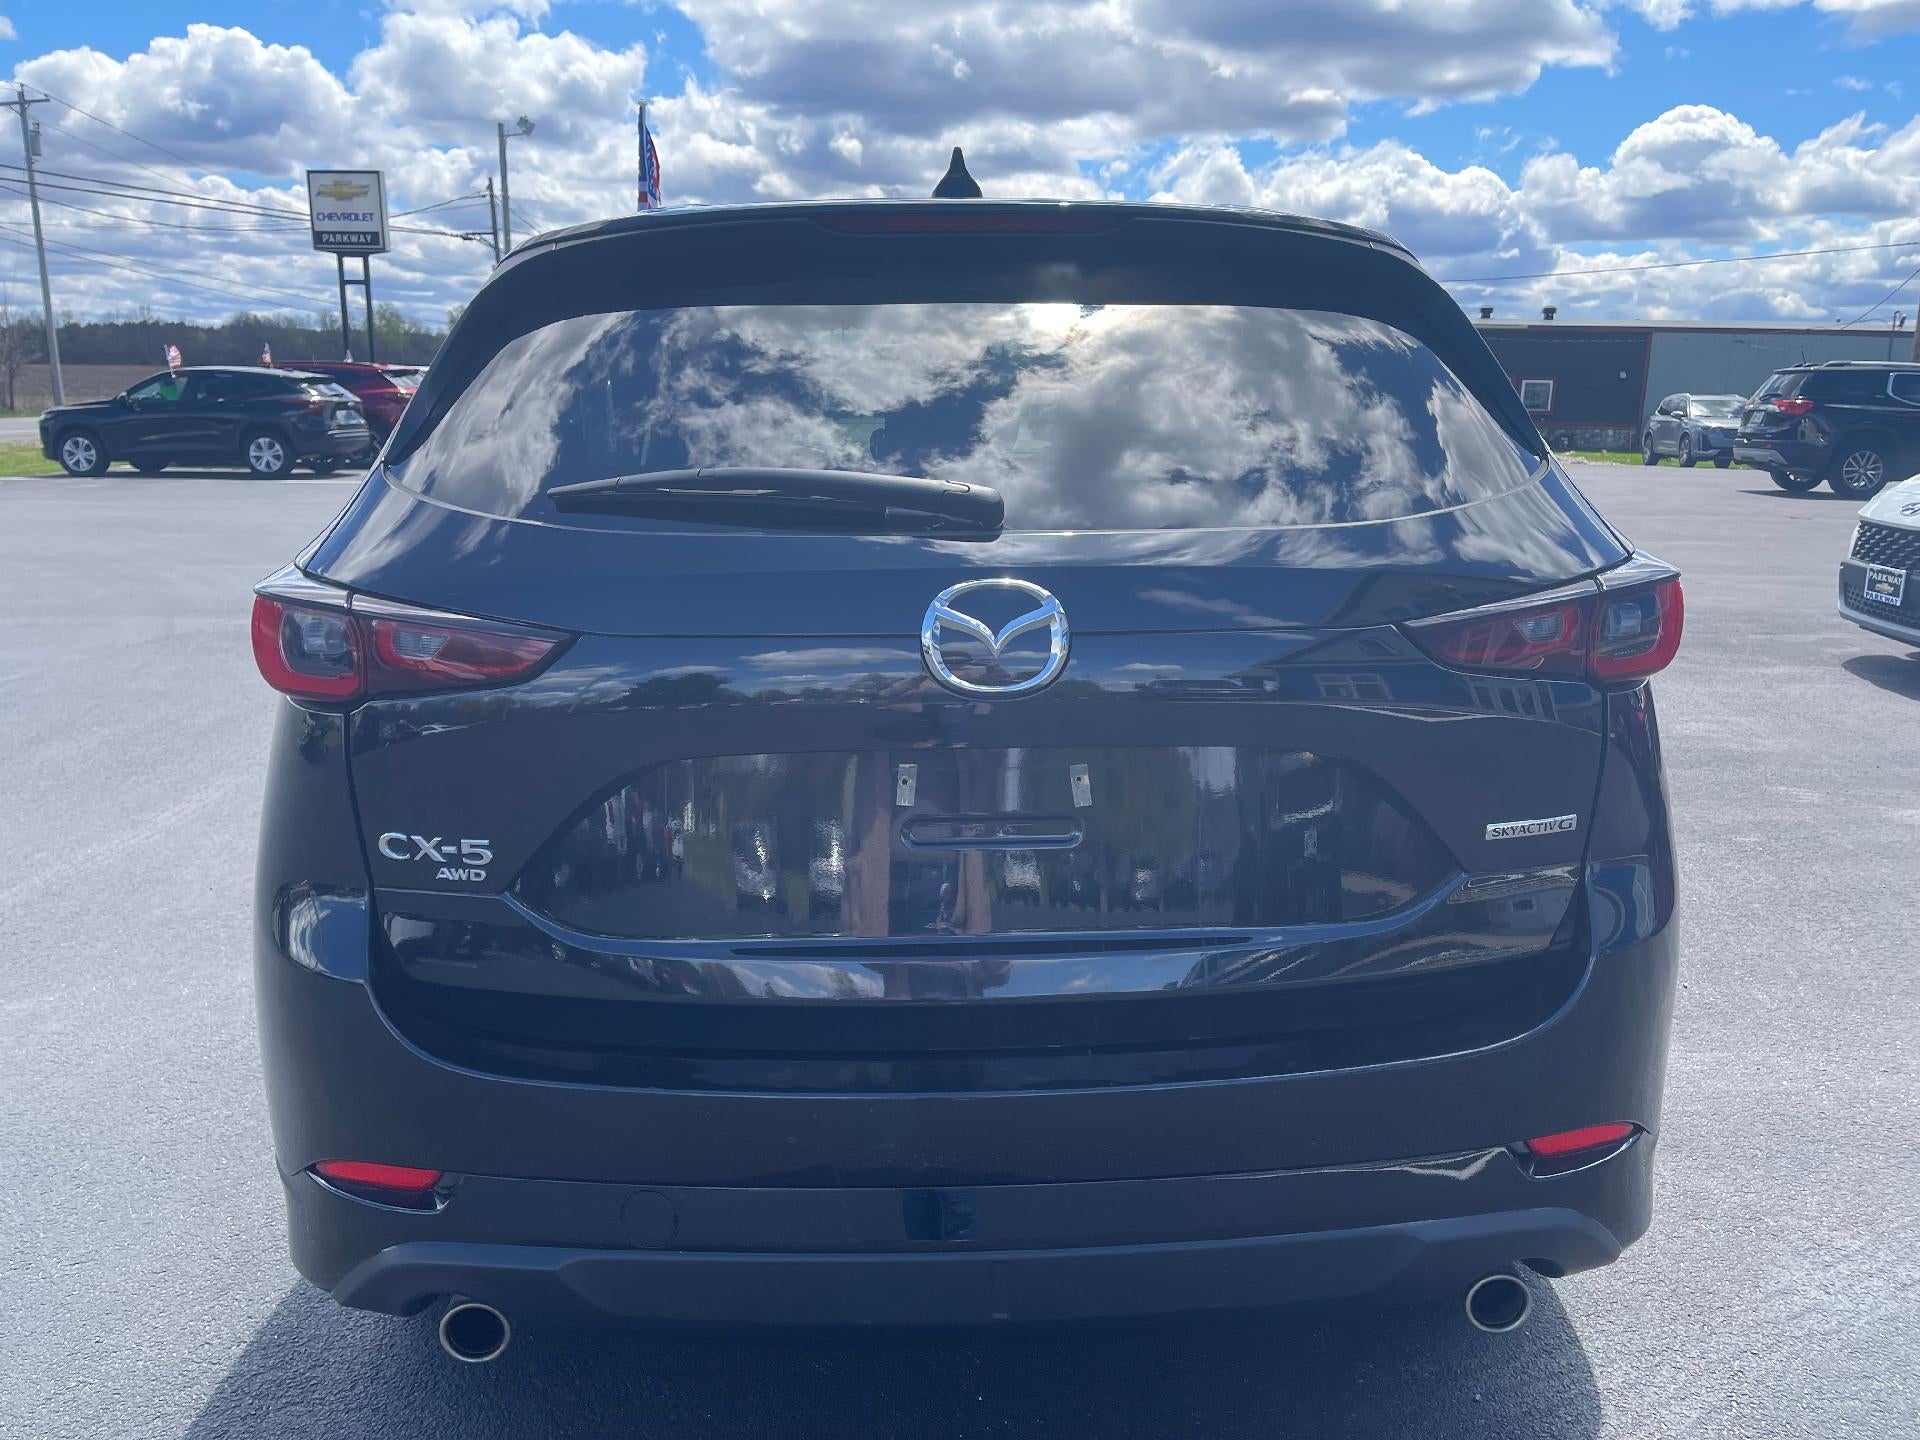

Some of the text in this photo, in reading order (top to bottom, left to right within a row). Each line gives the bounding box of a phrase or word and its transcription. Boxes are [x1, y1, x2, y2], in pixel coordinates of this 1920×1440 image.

[316, 212, 374, 222] CHEVROLET
[322, 233, 372, 243] PARKWAY
[1869, 571, 1903, 585] PARKWAY
[378, 832, 493, 866] CX-5
[436, 867, 486, 882] AWD
